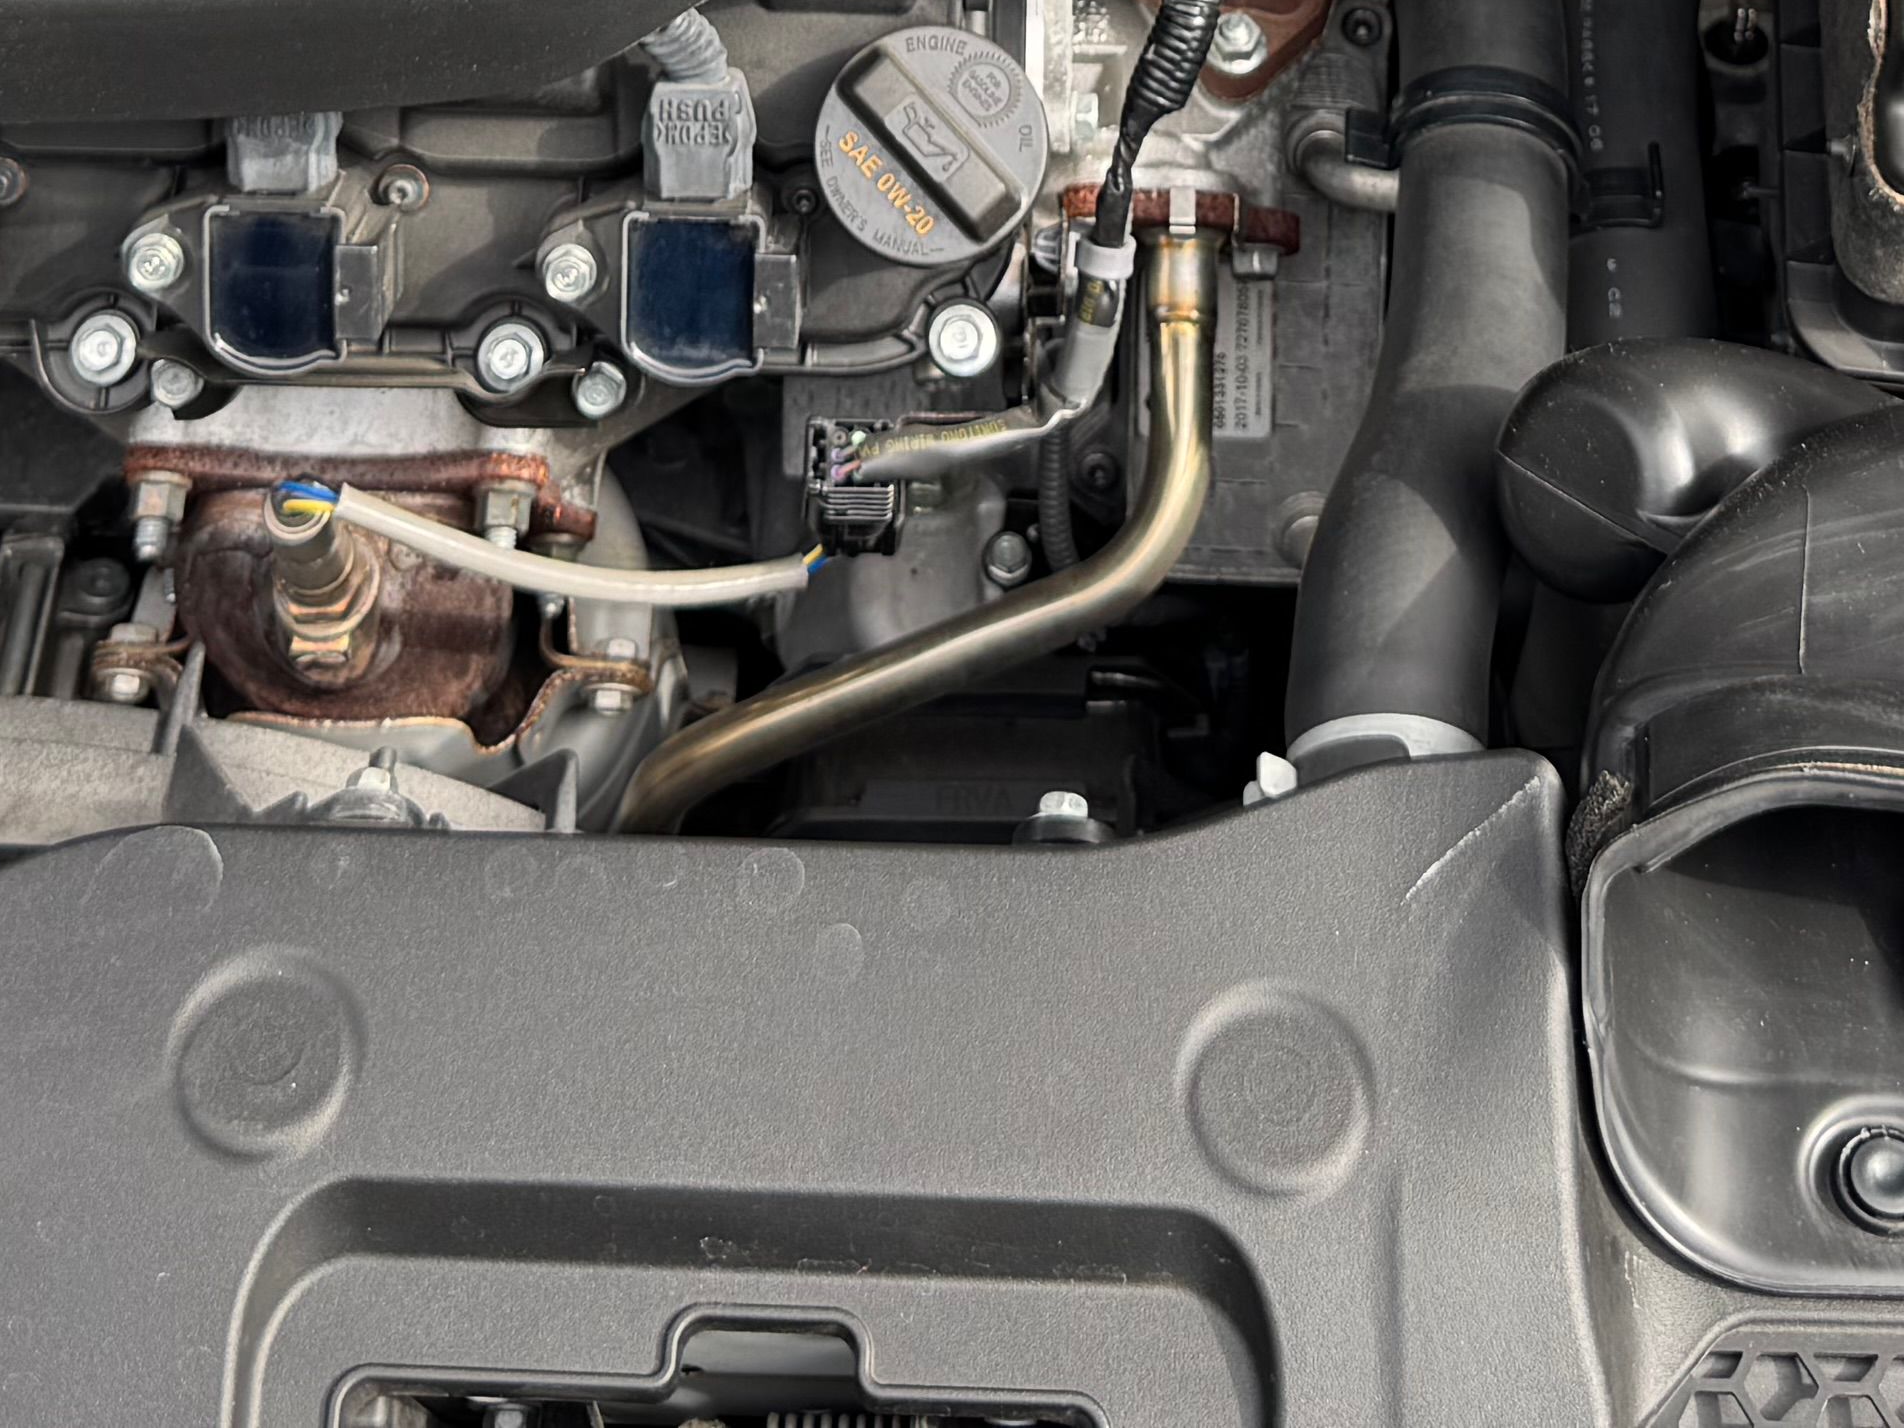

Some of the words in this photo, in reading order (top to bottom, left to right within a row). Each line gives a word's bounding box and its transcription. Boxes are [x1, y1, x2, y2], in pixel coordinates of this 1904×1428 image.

[659, 99, 729, 122] PUSH
[906, 35, 968, 56] ENGINE
[1018, 124, 1033, 153] OIL
[826, 176, 868, 232] OWNER'S
[839, 131, 883, 179] SAE
[877, 173, 935, 236] 0W-20
